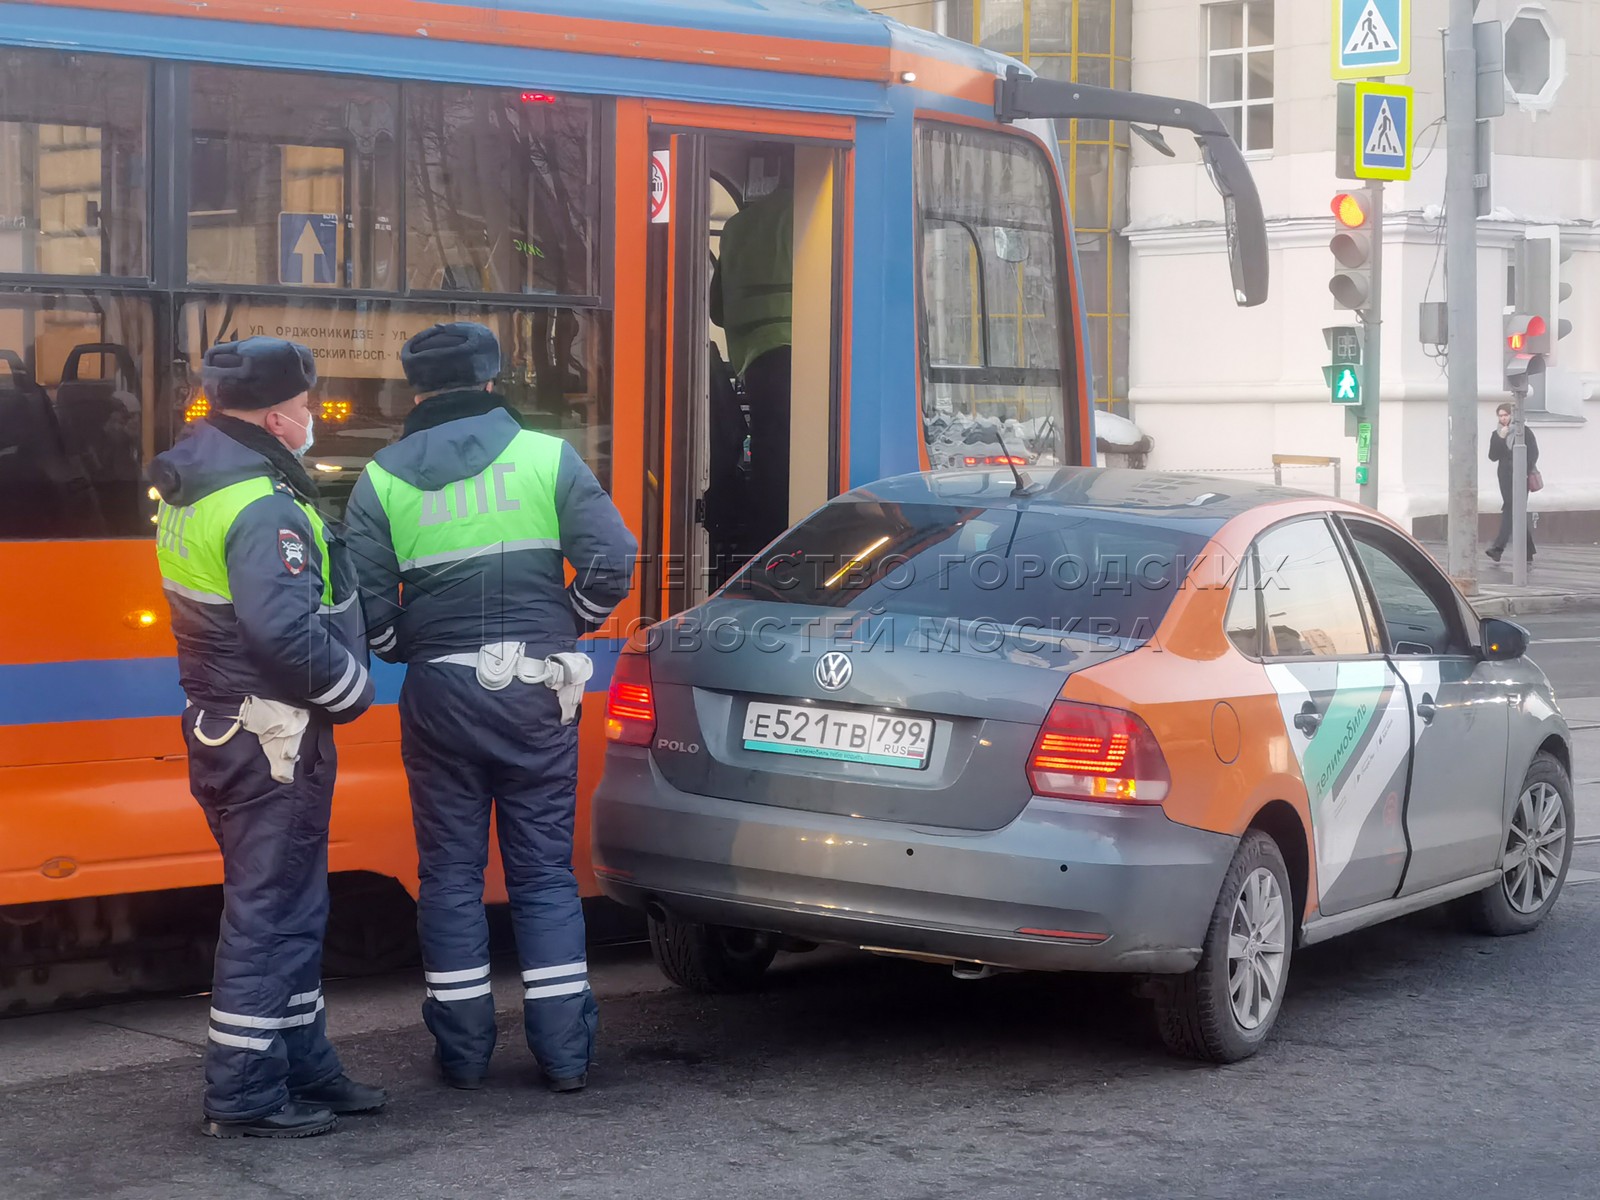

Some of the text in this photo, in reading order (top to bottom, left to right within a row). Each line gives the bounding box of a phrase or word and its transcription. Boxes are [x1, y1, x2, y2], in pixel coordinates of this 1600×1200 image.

[275, 326, 373, 340] ОРДЖОНИКИДЗЕ
[311, 348, 346, 359] ВСКИЙ
[419, 462, 520, 527] ДПС
[876, 718, 923, 746] 799
[657, 739, 700, 754] POLO
[883, 744, 907, 756] RUS
